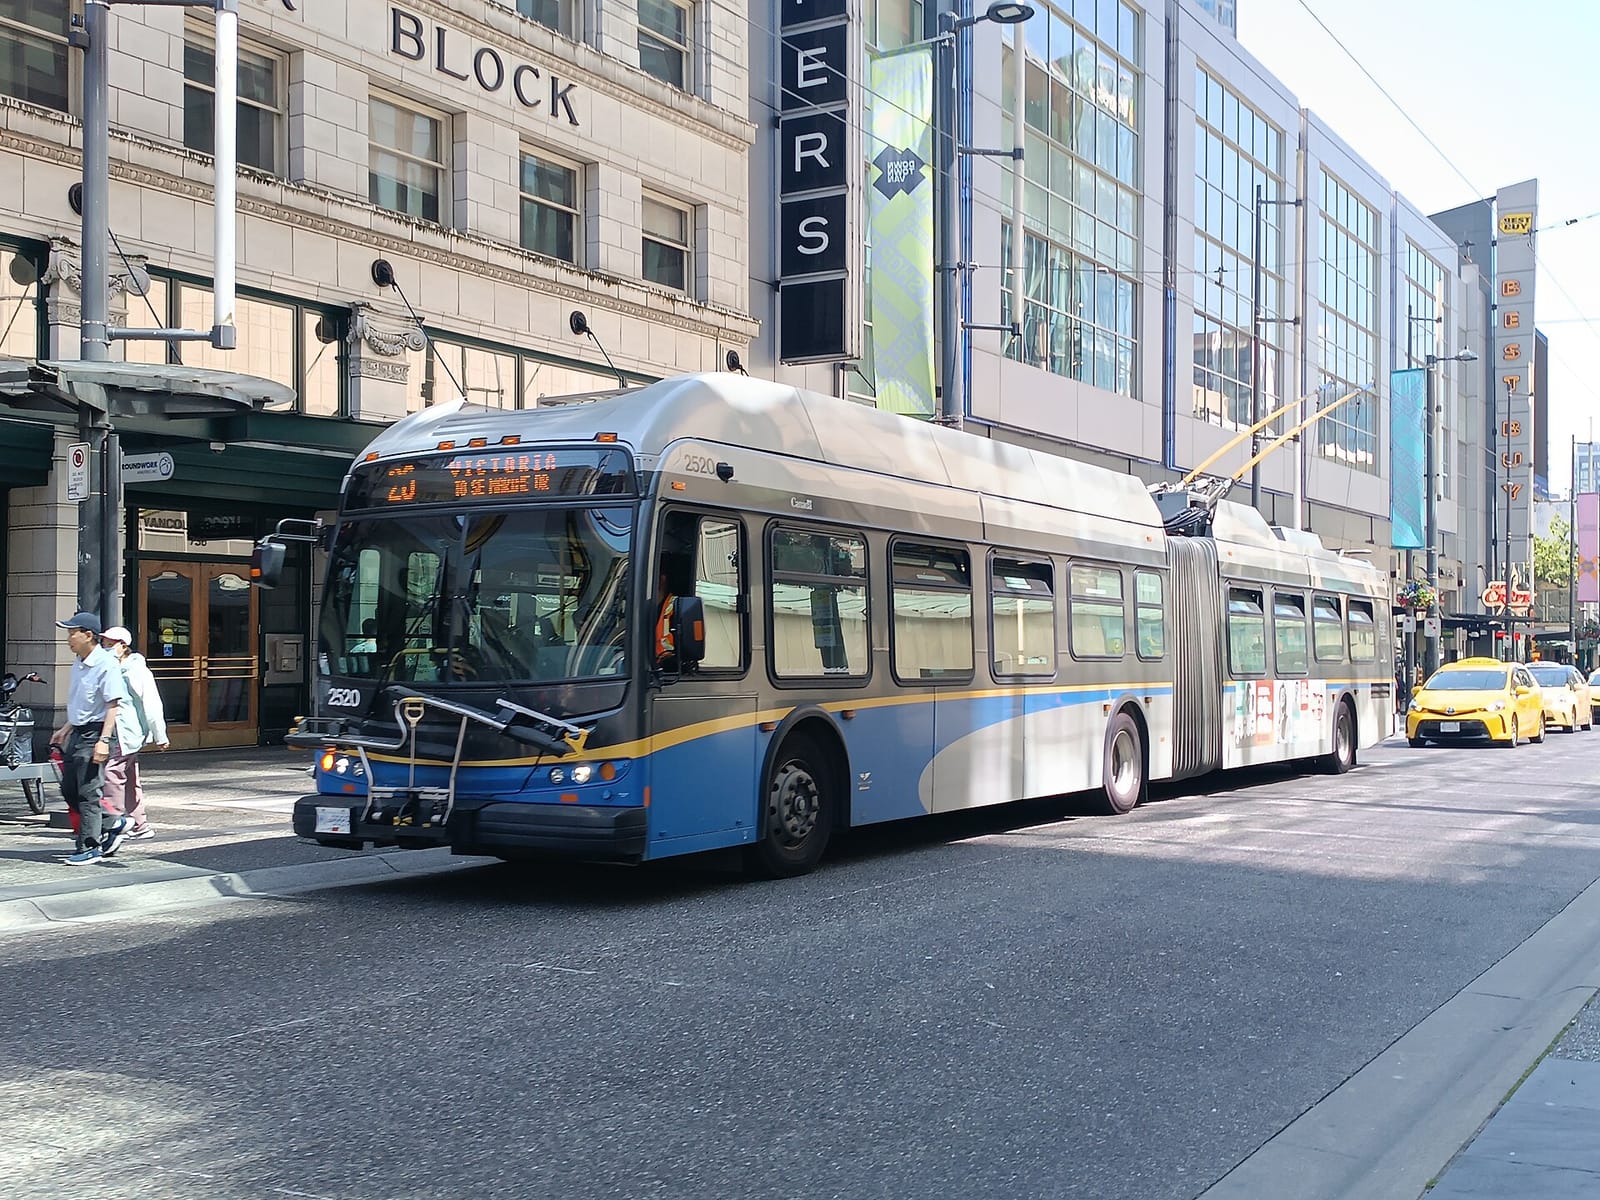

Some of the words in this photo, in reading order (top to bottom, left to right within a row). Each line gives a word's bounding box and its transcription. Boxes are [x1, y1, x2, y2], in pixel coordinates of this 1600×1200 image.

[390, 7, 580, 126] BLOCK
[795, 0, 830, 255] ERS
[1503, 216, 1530, 224] BEST
[1501, 279, 1521, 392] BEST
[449, 453, 557, 478] VICTORIA
[684, 454, 715, 475] 2520
[1501, 420, 1523, 501] BUY
[144, 516, 185, 529] VANCO
[327, 687, 361, 707] 2520
